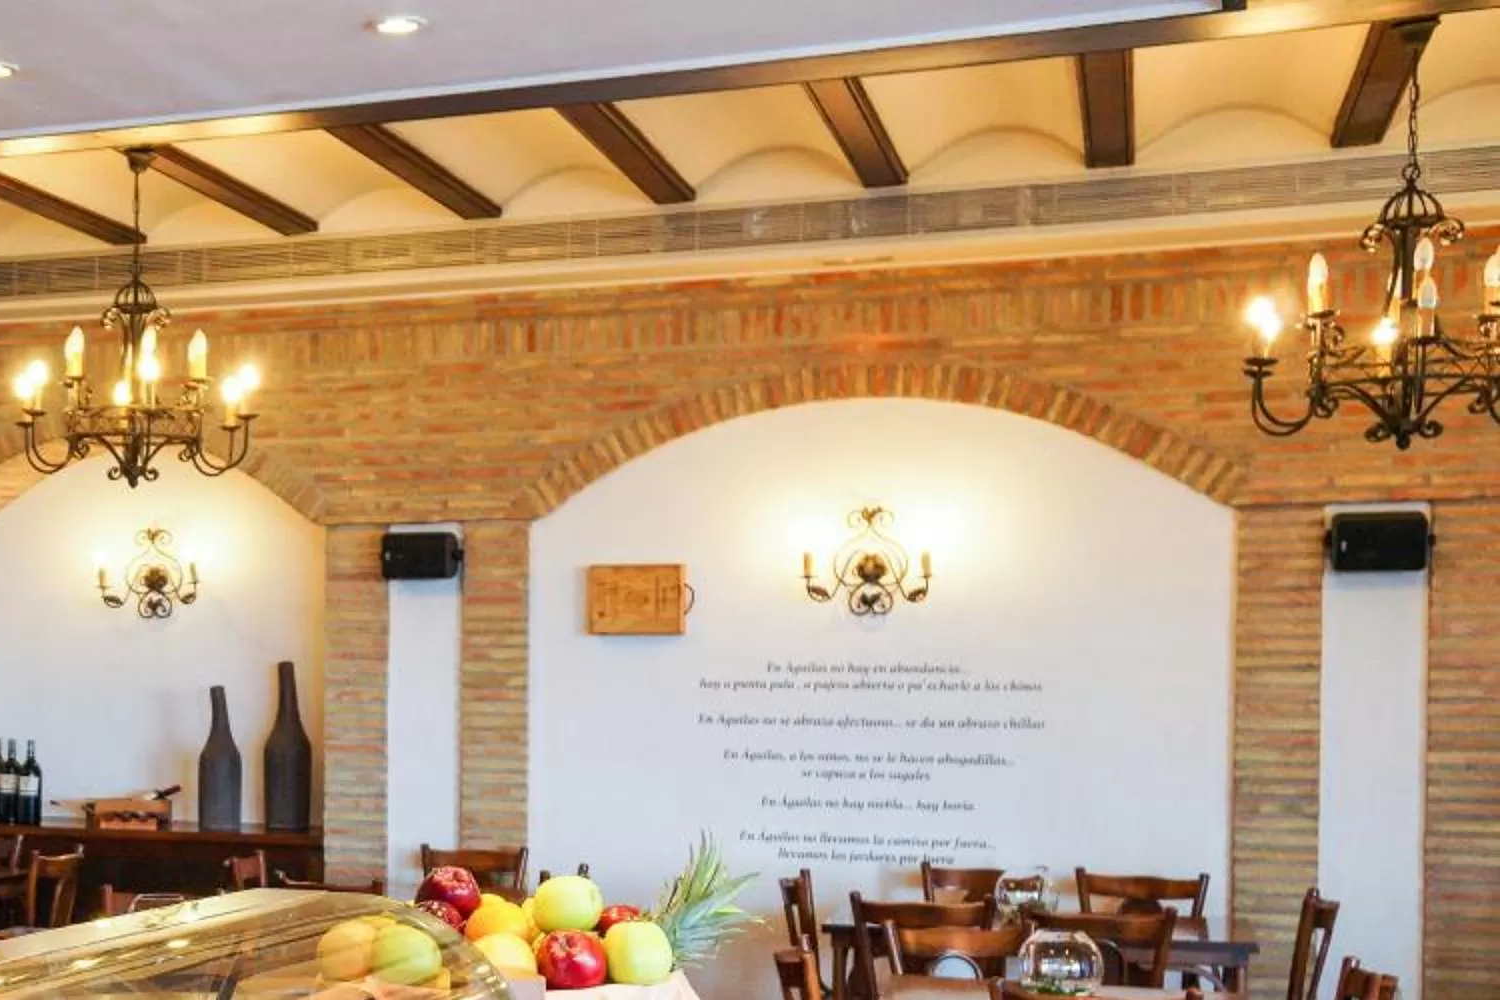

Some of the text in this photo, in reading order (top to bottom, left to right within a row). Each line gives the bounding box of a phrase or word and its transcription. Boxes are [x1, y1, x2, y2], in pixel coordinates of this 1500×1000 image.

[847, 661, 869, 677] hay
[841, 796, 865, 811] hay
[915, 799, 940, 812] hay
